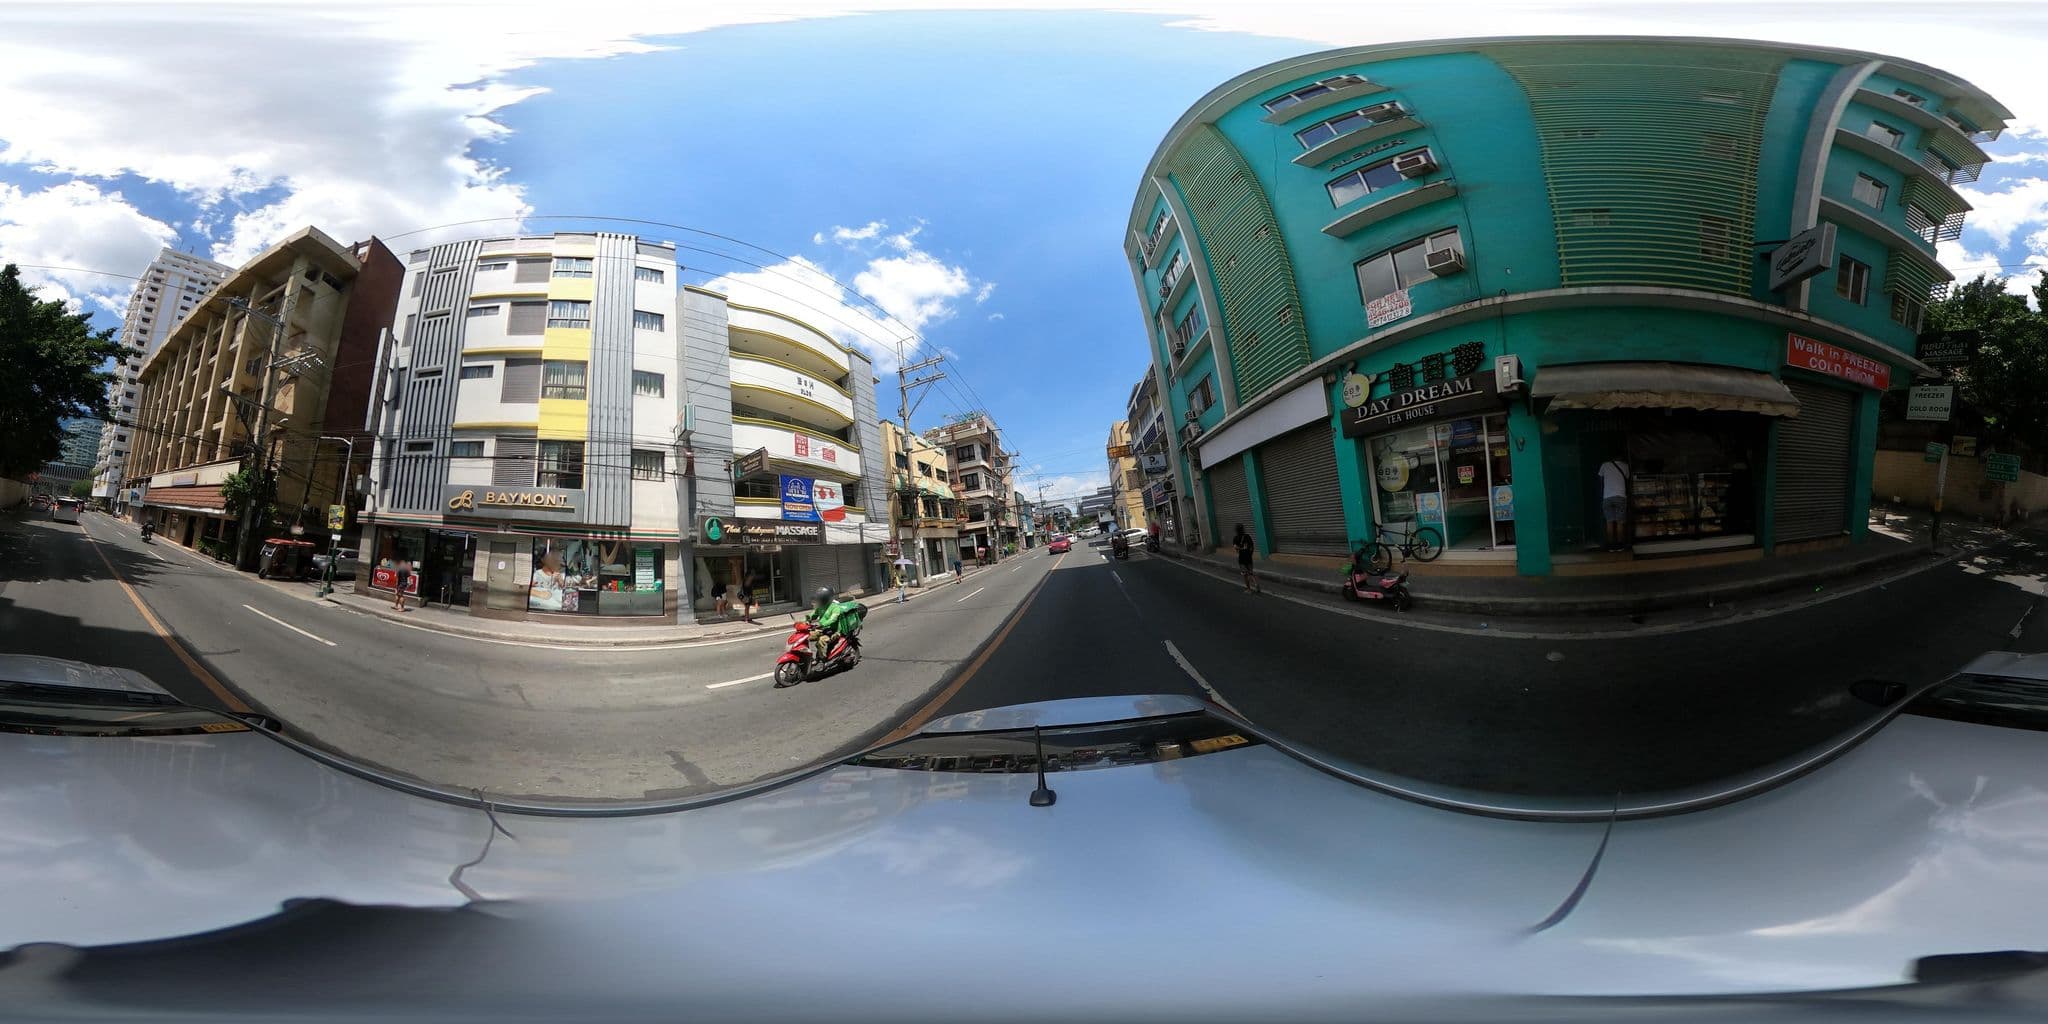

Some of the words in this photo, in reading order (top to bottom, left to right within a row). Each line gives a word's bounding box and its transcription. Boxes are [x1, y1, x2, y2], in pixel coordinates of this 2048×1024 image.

[1794, 337, 1825, 356] Walk
[1829, 347, 1840, 360] in
[1843, 352, 1888, 376] FREEZER
[1924, 348, 1964, 357] MASSAGE
[1809, 357, 1842, 375] COLD
[1845, 366, 1875, 386] ROOM
[1358, 398, 1391, 419] DAY
[1401, 377, 1473, 407] DREAM
[1386, 413, 1402, 425] TEA
[1405, 405, 1435, 421] HOUSE
[486, 491, 568, 507] BAYMONT
[776, 525, 818, 535] MASSAGE
